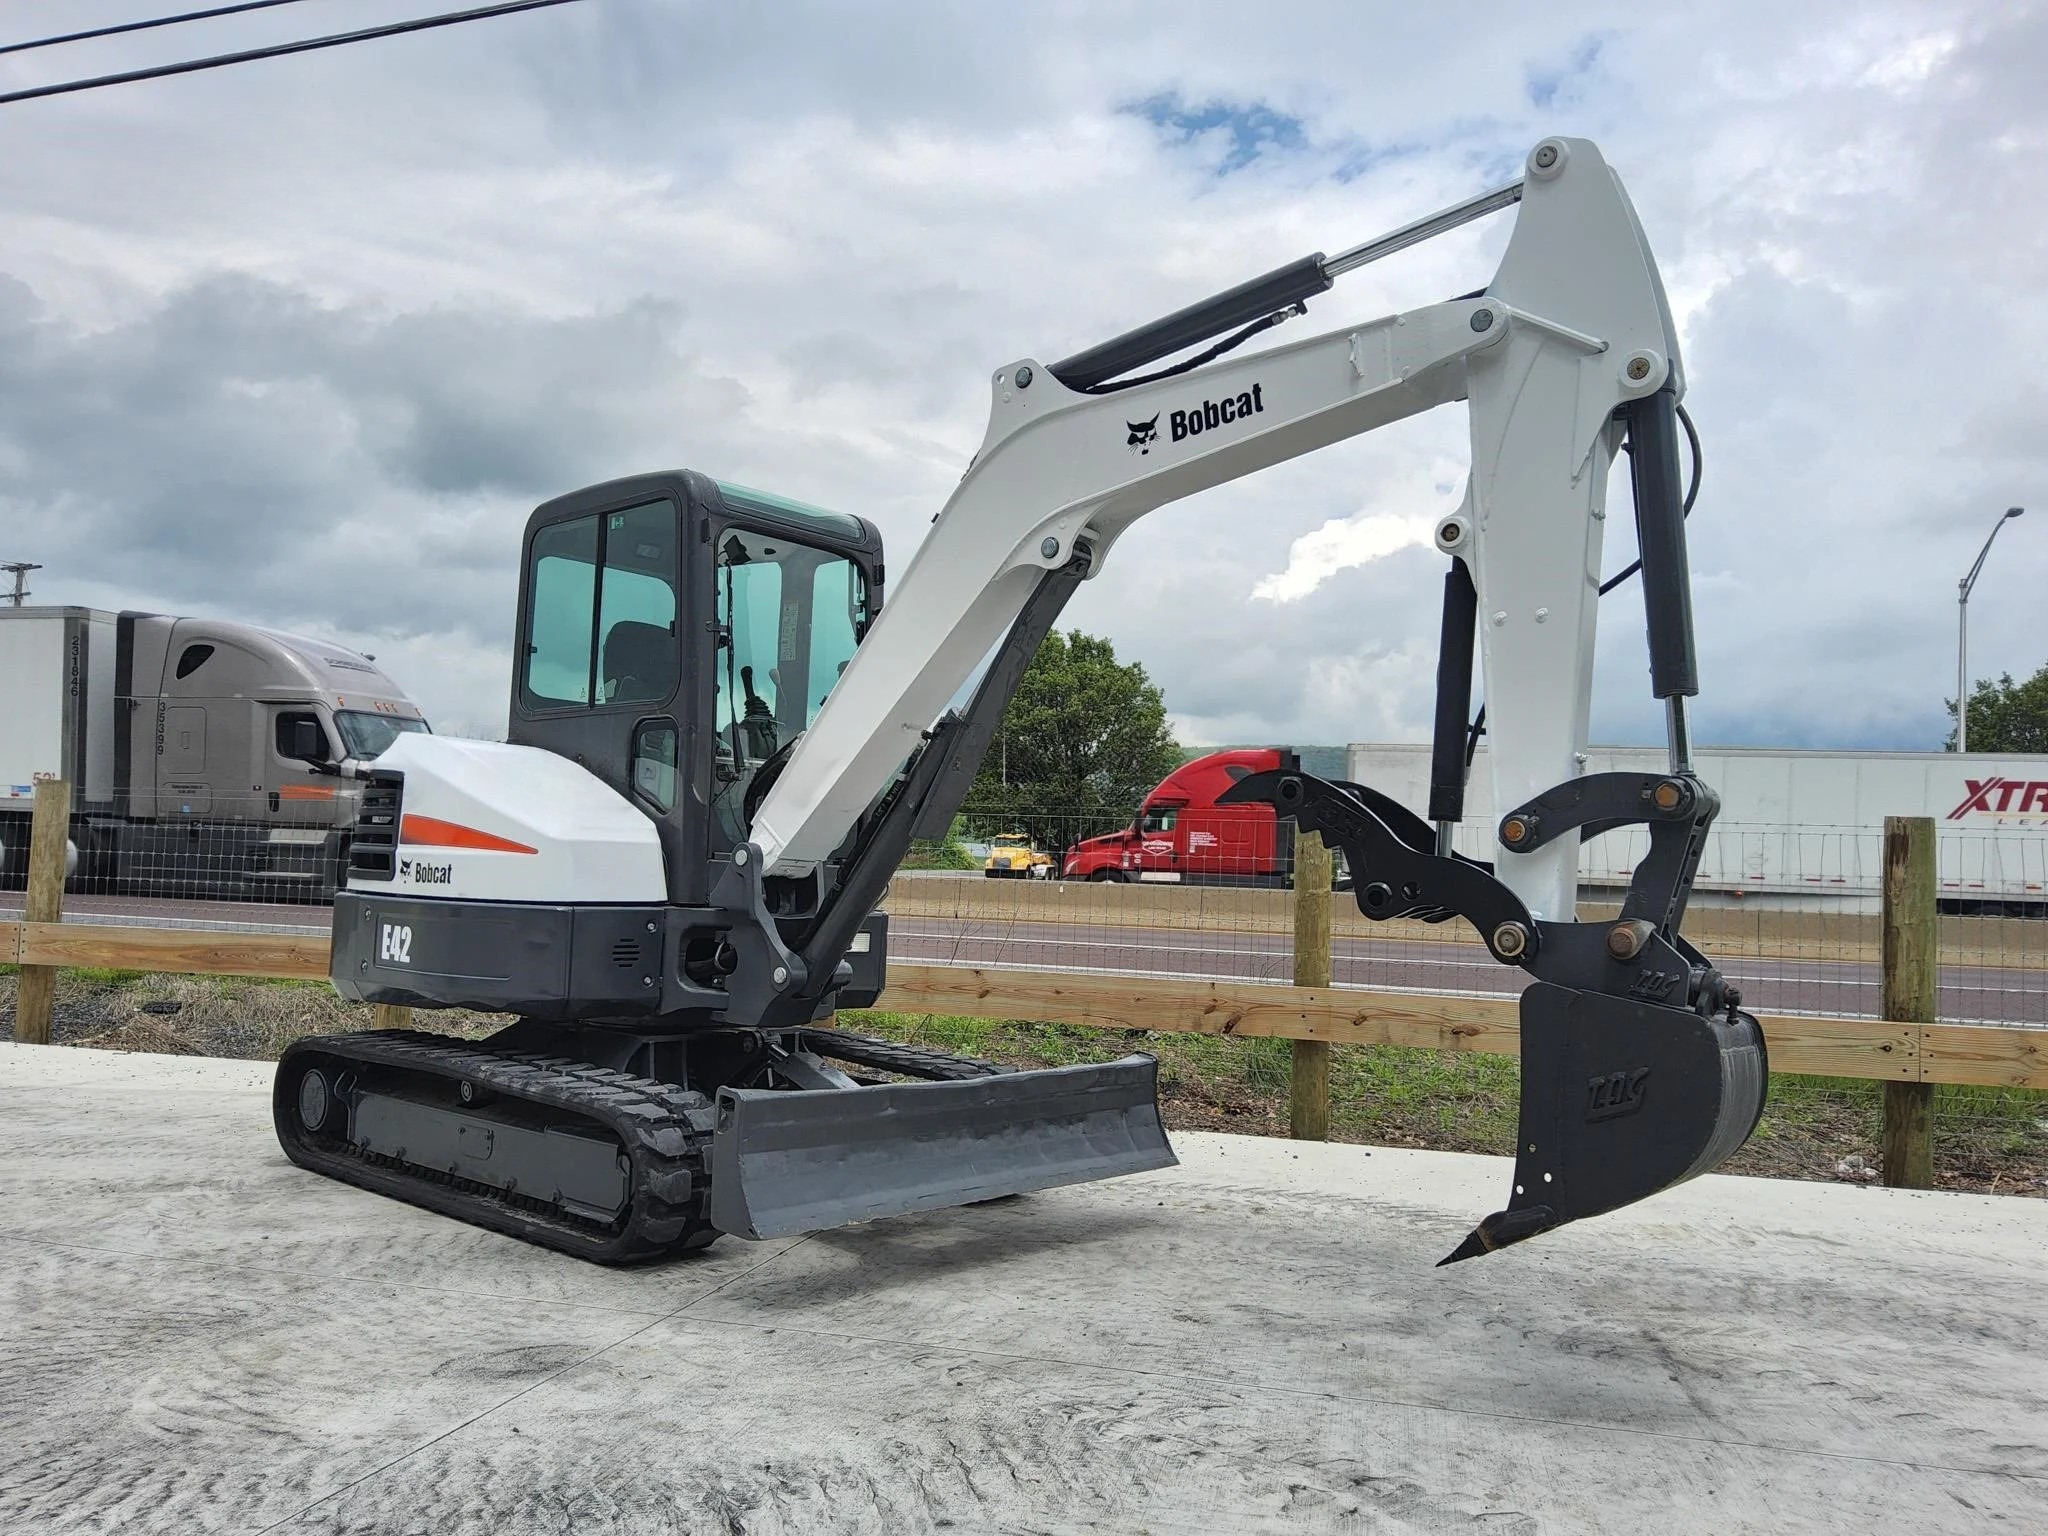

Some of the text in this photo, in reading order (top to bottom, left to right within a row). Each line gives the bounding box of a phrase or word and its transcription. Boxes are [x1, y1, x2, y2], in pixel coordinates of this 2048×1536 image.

[1170, 382, 1264, 443] Bobcat
[157, 702, 166, 756] 35399
[1945, 777, 2048, 820] XTR
[414, 862, 453, 885] Bobcat
[380, 923, 413, 964] E42
